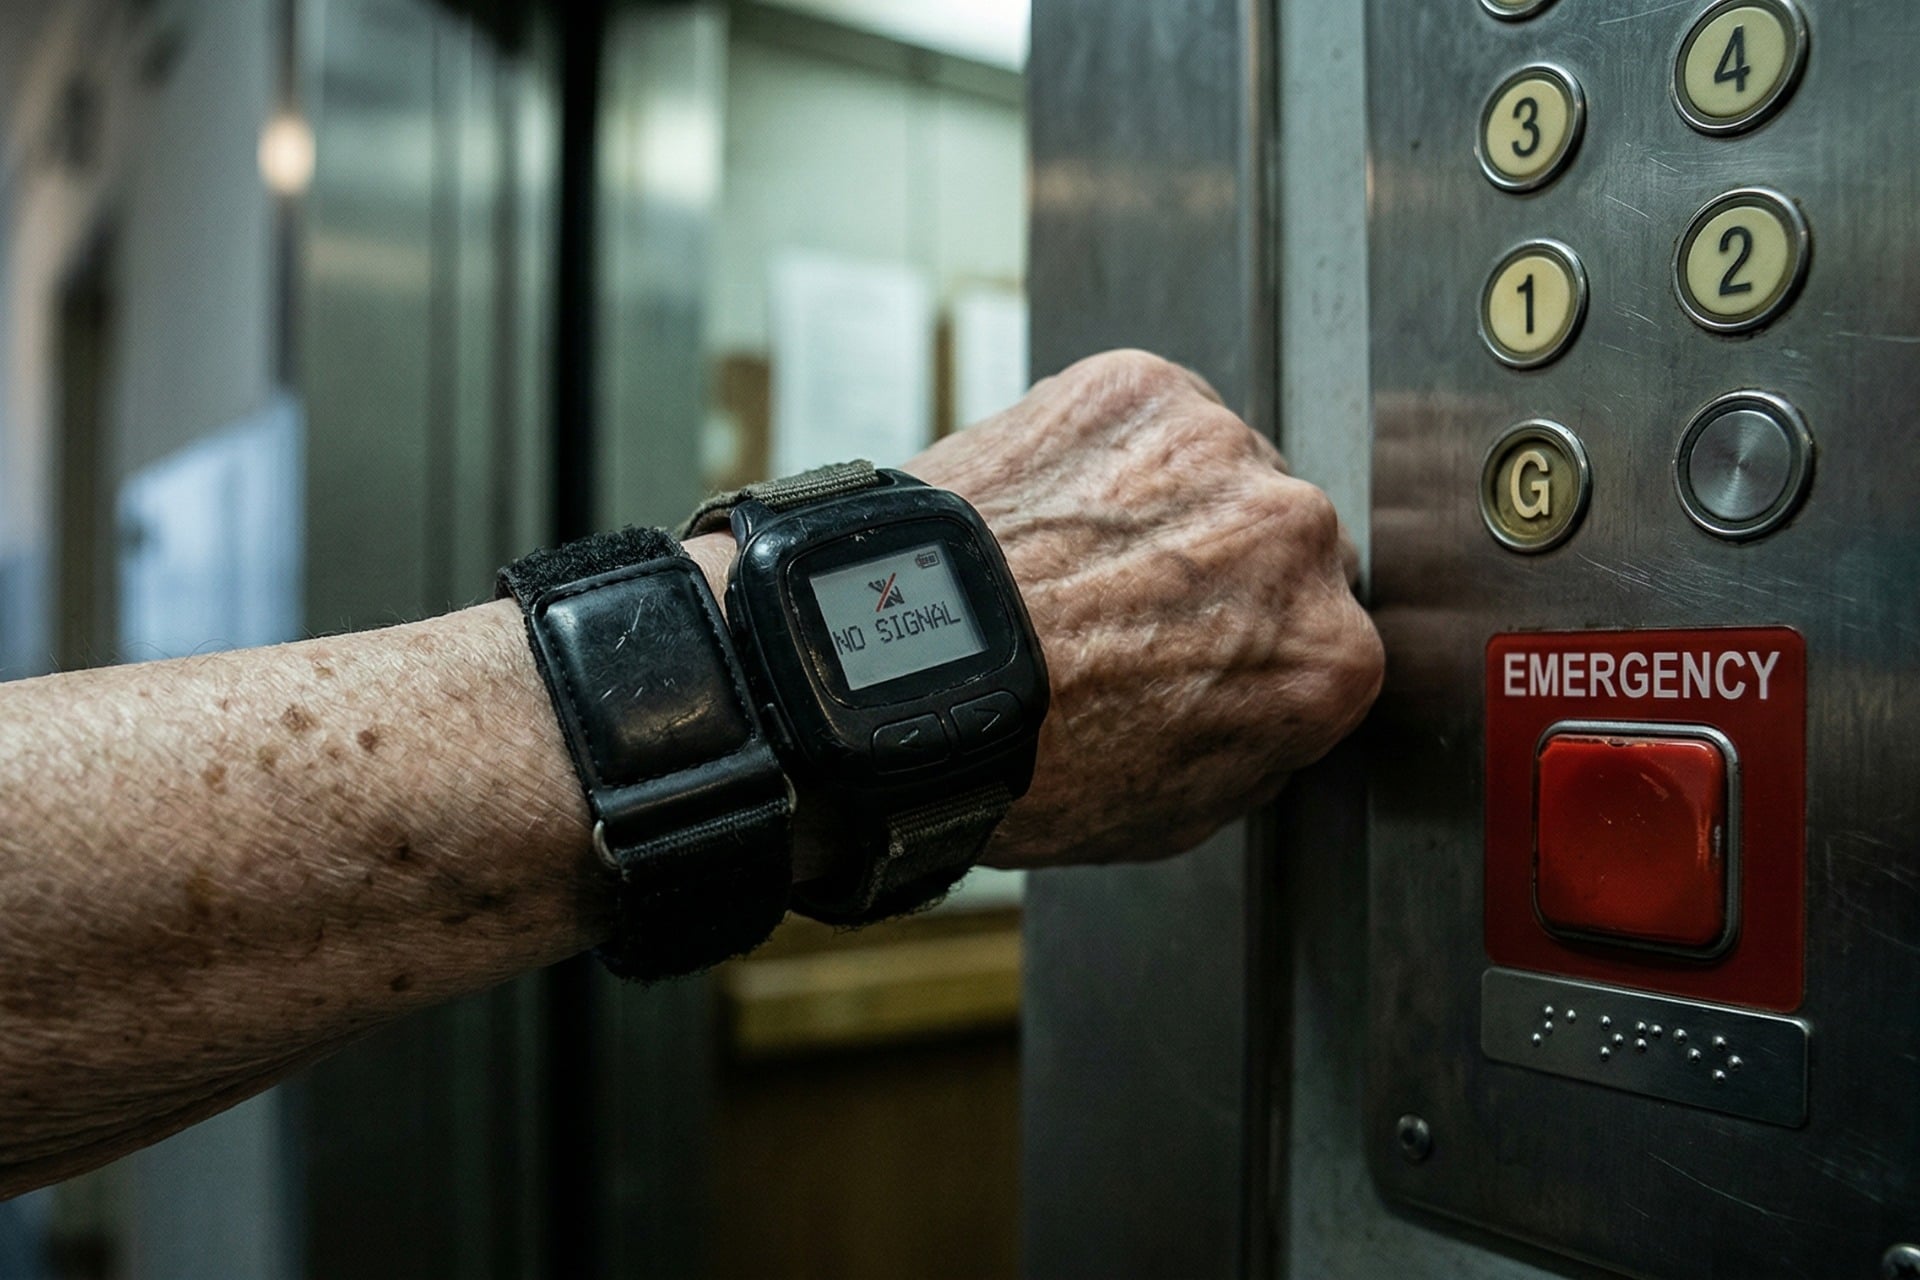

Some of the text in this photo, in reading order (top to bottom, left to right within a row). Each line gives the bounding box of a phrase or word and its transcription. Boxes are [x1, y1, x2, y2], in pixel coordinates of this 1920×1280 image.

[1713, 25, 1751, 93] 4
[1511, 96, 1541, 158] 3
[1718, 226, 1753, 297] 2
[1516, 273, 1535, 335] 1
[1510, 450, 1550, 520] G
[832, 600, 961, 656] NO SIGNAL
[1503, 650, 1780, 701] EMERGENCY
